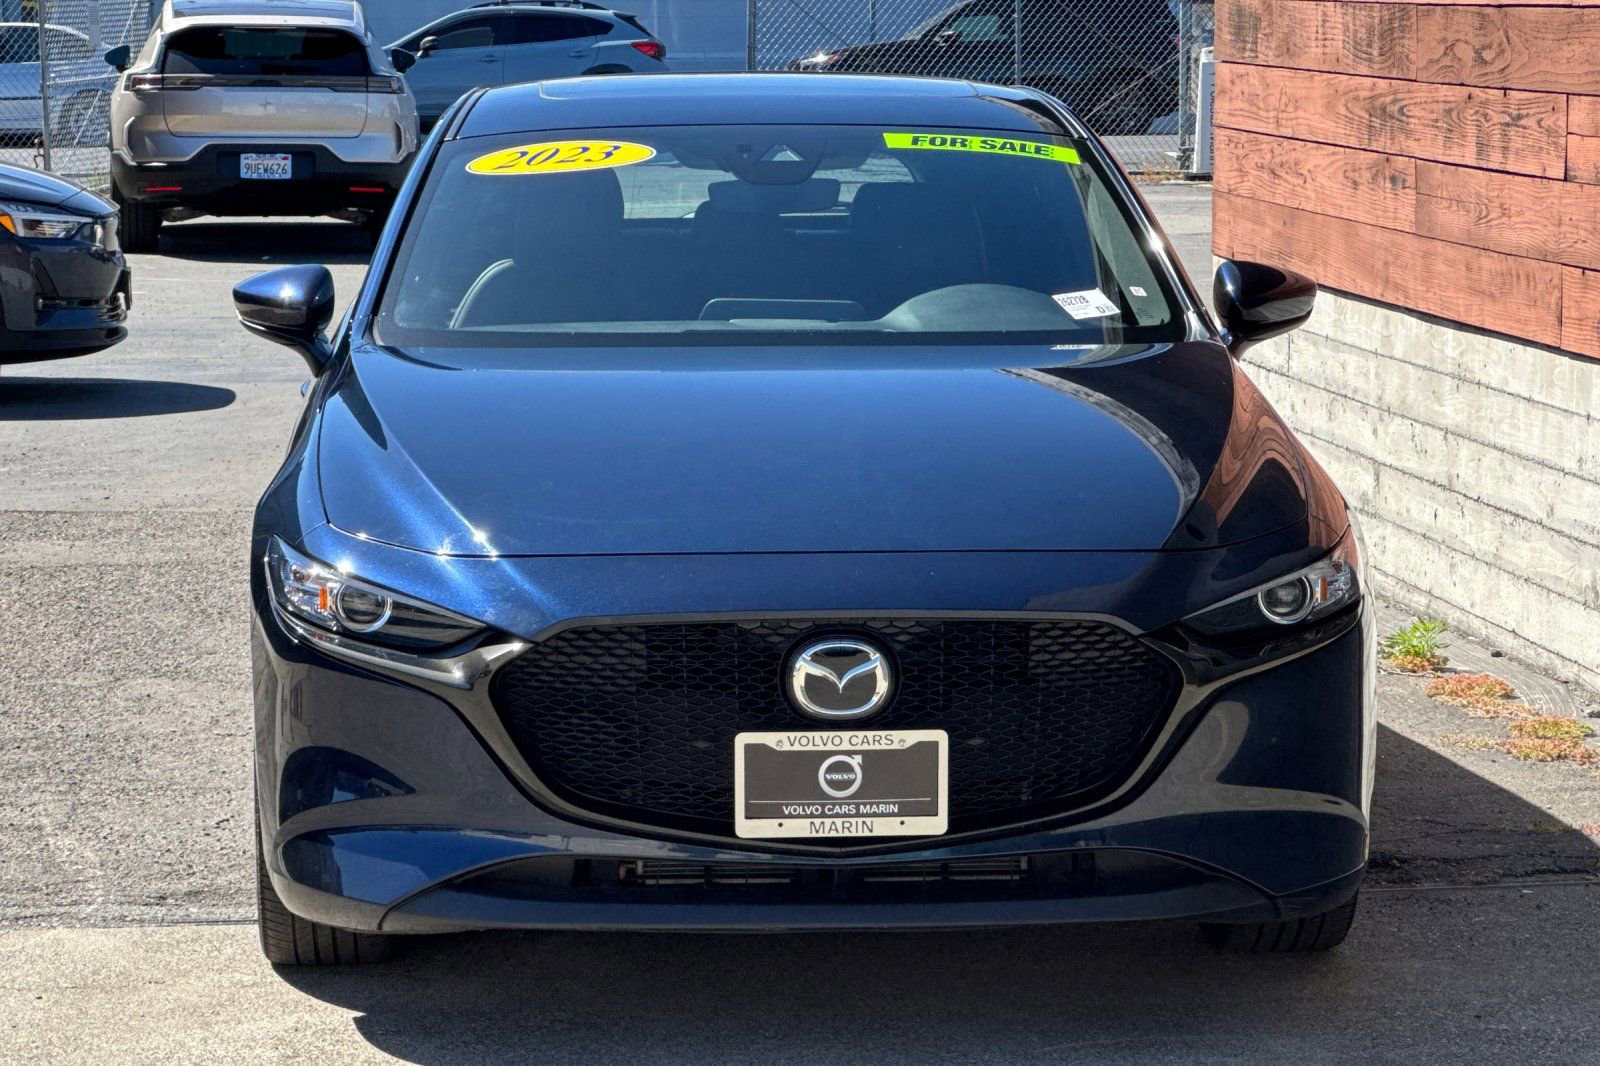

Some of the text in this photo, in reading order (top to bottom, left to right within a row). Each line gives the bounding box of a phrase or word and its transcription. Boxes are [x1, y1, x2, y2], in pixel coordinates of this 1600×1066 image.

[911, 135, 1054, 158] FOR SALE
[492, 145, 622, 170] 2023
[244, 162, 288, 175] 9UEW626
[787, 734, 894, 748] VOLVO CARS
[782, 803, 899, 815] VOLVO CARS MARIN
[809, 820, 874, 835] MARIN
